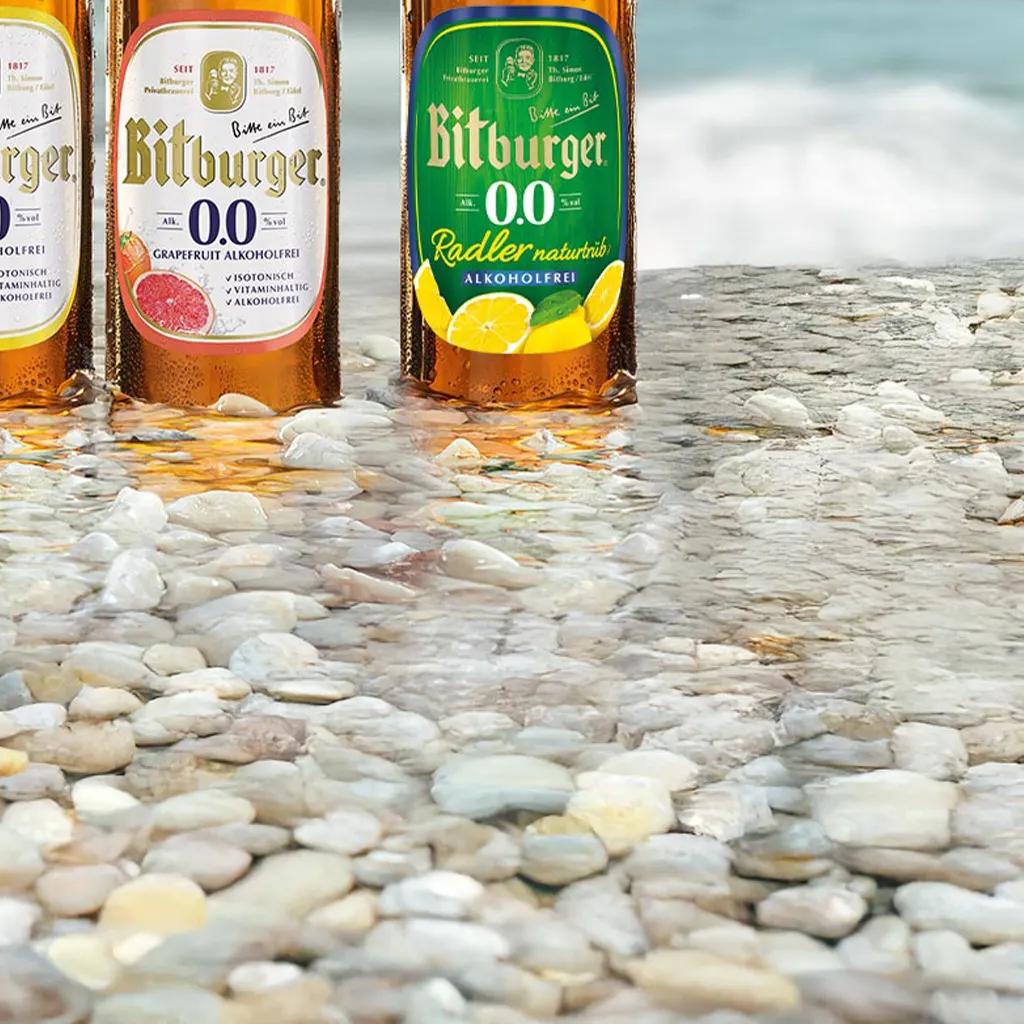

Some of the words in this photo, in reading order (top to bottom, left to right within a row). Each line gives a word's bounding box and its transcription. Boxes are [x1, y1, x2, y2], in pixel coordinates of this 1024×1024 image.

[8, 62, 29, 70] 1817
[469, 55, 488, 63] SEIT
[548, 54, 569, 62] 1817
[173, 65, 193, 73] SEIT
[254, 65, 275, 73] 1817
[21, 116, 39, 126] ein
[42, 103, 62, 119] Bit
[529, 106, 560, 122] Bitte
[583, 92, 599, 107] Bit
[232, 121, 262, 138] Bitte
[267, 120, 285, 130] ein
[289, 107, 309, 123] Bit
[427, 102, 606, 180] Bitburger
[122, 117, 322, 197] Bitburger
[460, 198, 475, 206] Alk.
[485, 180, 555, 225] 0.0
[162, 217, 179, 226] Alk.
[189, 199, 257, 246] 0.0
[153, 248, 221, 260] GRAPEFRUIT
[224, 248, 300, 260] ALKOHOLFREI
[431, 228, 533, 267] Radler
[533, 236, 607, 262] naturtrüb
[234, 272, 294, 282] ISOTONISCH
[464, 272, 576, 285] ALKOHOLFREI
[234, 283, 309, 294] VITAMINHALTIG
[234, 296, 299, 306] ALKOHOLFREI
